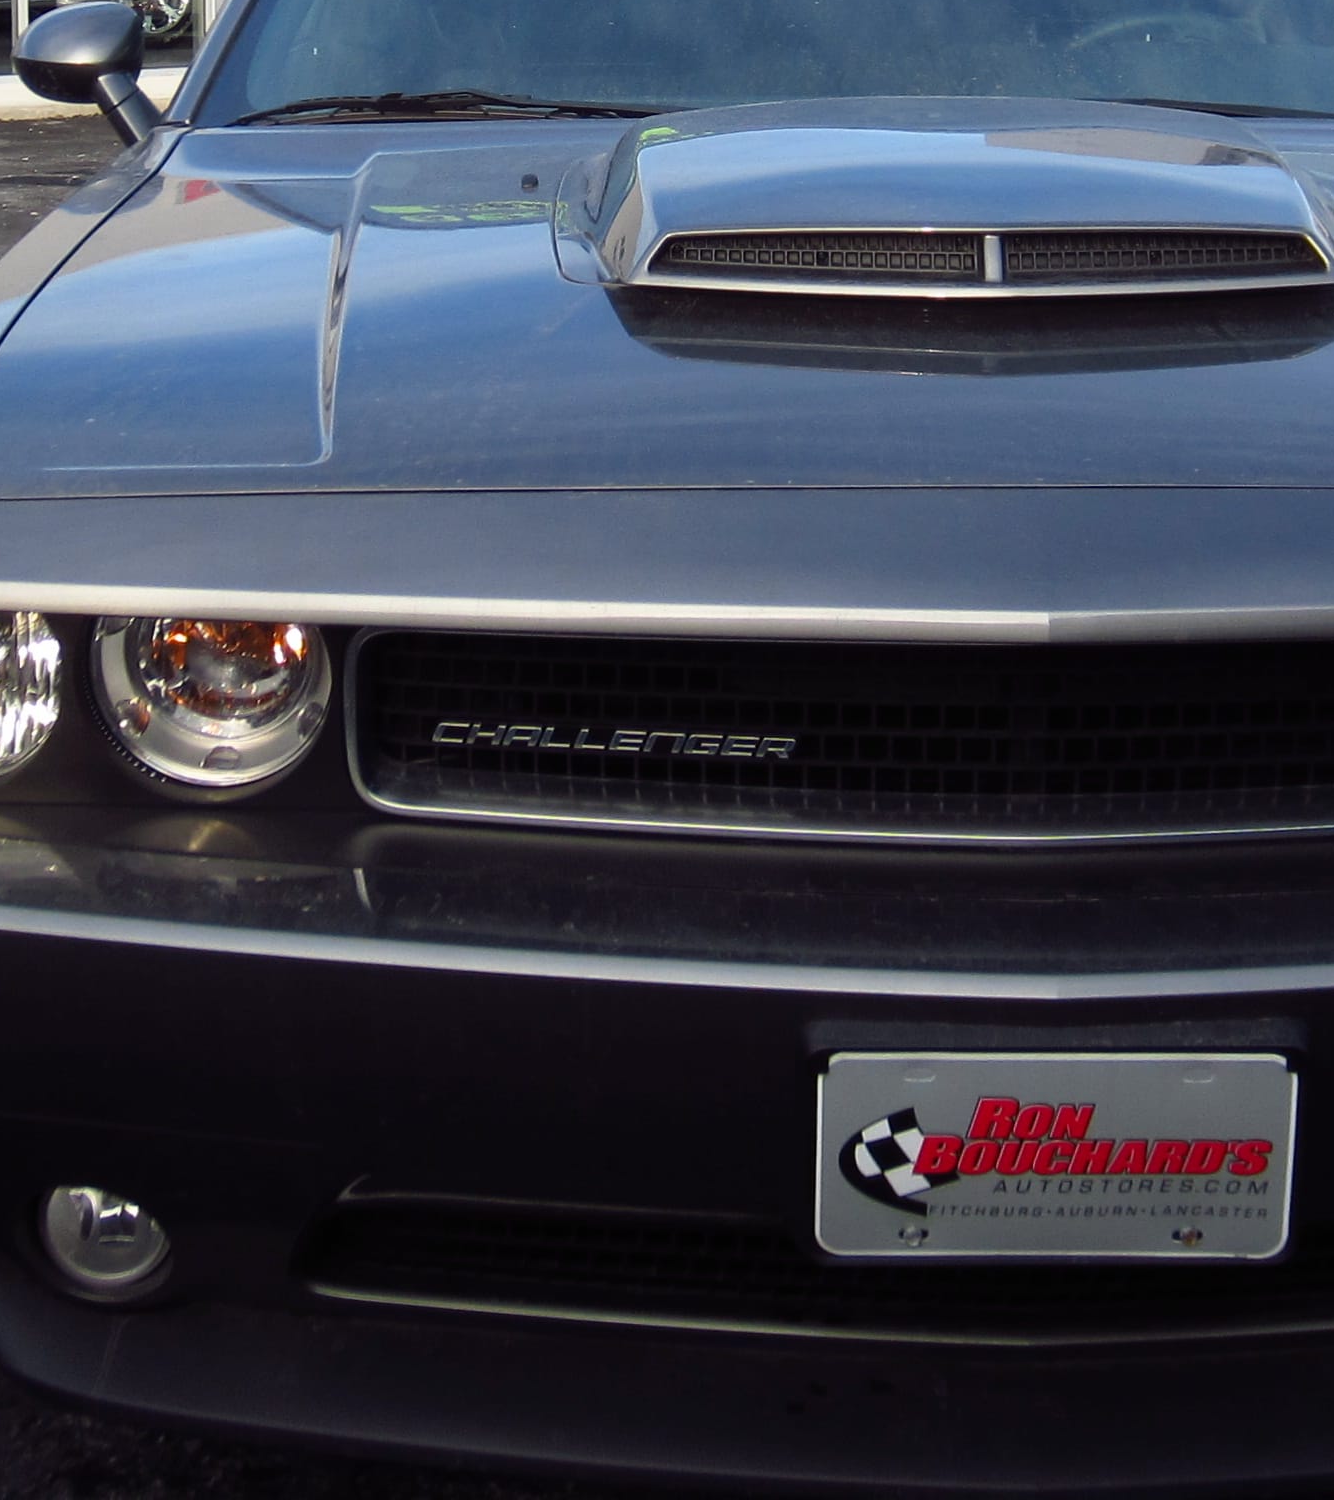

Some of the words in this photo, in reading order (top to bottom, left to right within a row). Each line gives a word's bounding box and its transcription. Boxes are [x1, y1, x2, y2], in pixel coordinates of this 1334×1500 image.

[432, 721, 797, 759] CHALLENGER
[966, 1096, 1096, 1140] RON
[911, 1134, 1273, 1177] BOUCHARD'S
[992, 1179, 1269, 1195] AUTOSTORES.COM
